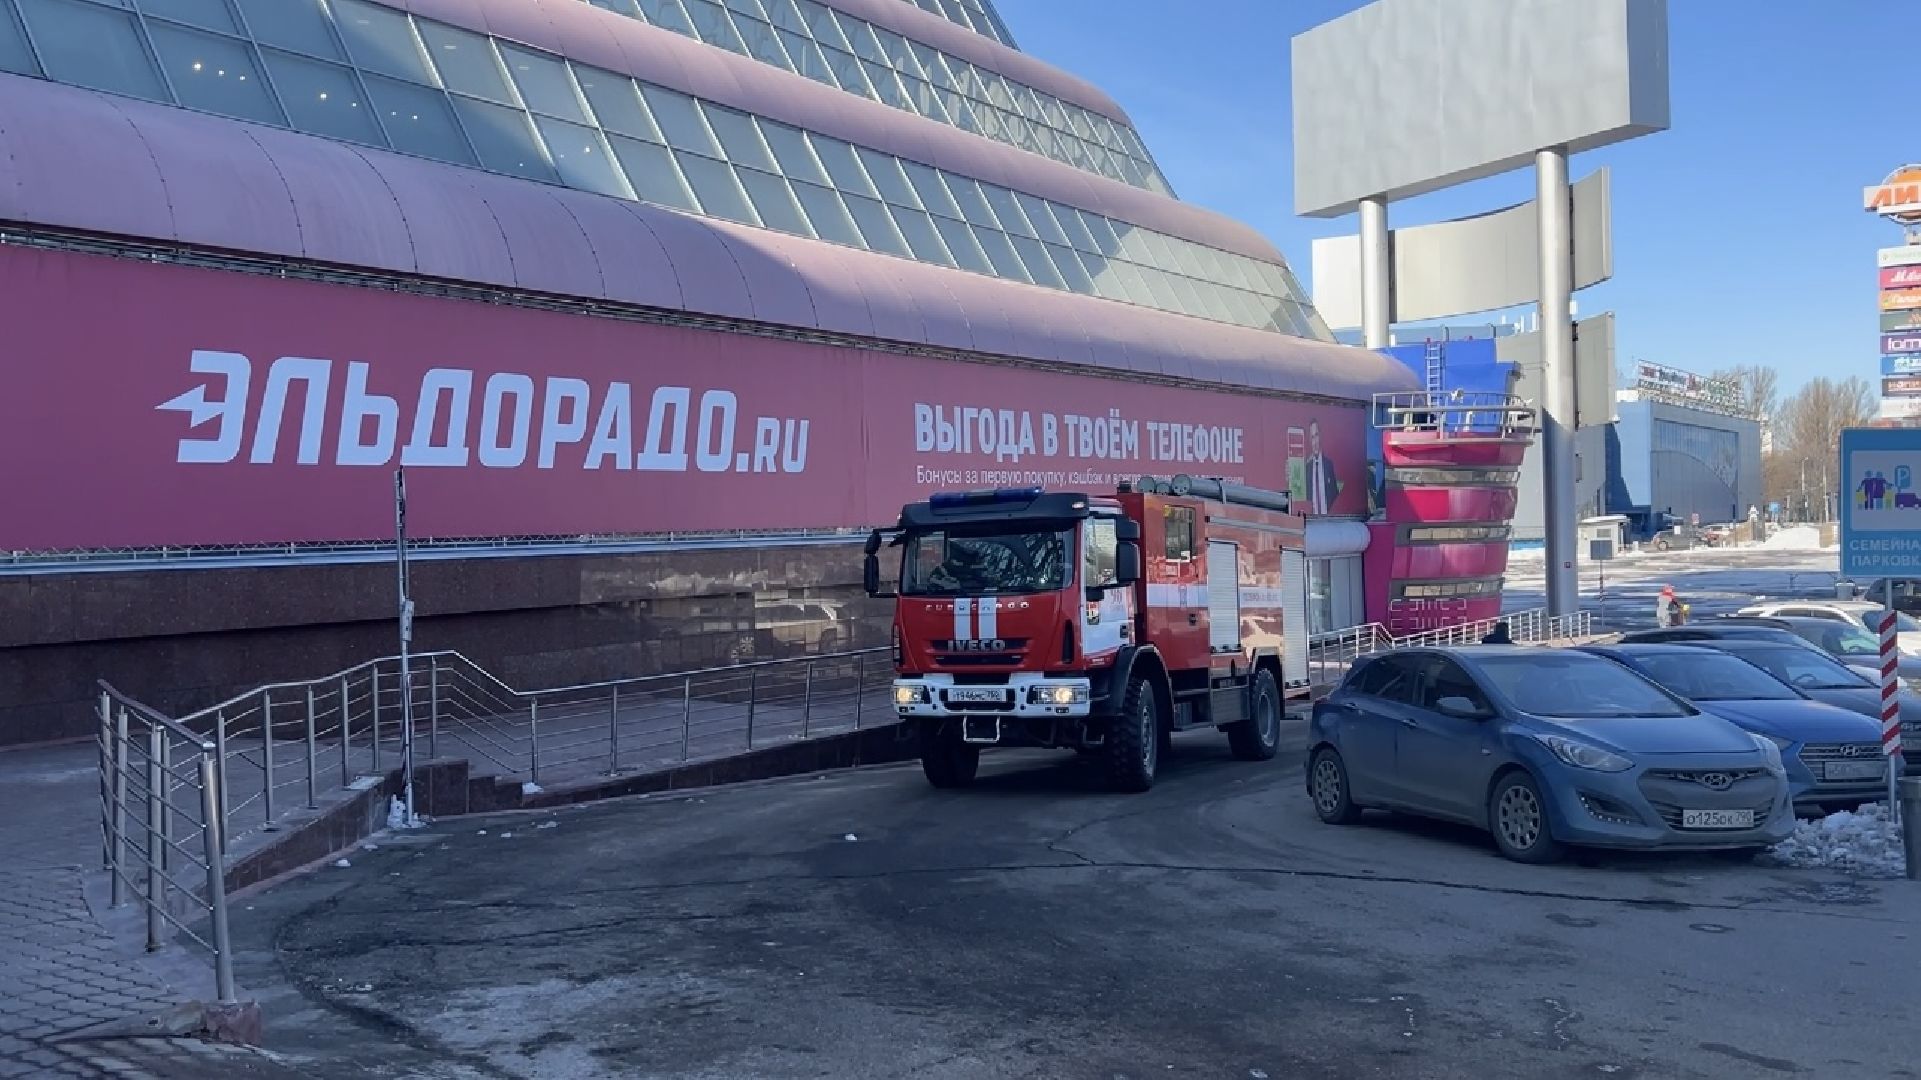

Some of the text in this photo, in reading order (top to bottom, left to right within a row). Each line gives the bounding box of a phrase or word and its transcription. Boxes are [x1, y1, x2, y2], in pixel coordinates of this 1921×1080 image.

[157, 349, 810, 473] ЭЛЬДОРАДО.RU
[914, 402, 1244, 464] ВЫГОДА В ТВОЁМ ТЕЛЕФОНЕ
[916, 465, 962, 487] Бонусы
[966, 470, 977, 484] за
[981, 470, 1022, 487] первую
[1024, 470, 1067, 487] покупку,
[1069, 467, 1103, 486] кэшбэк
[947, 639, 1006, 652] IVECO
